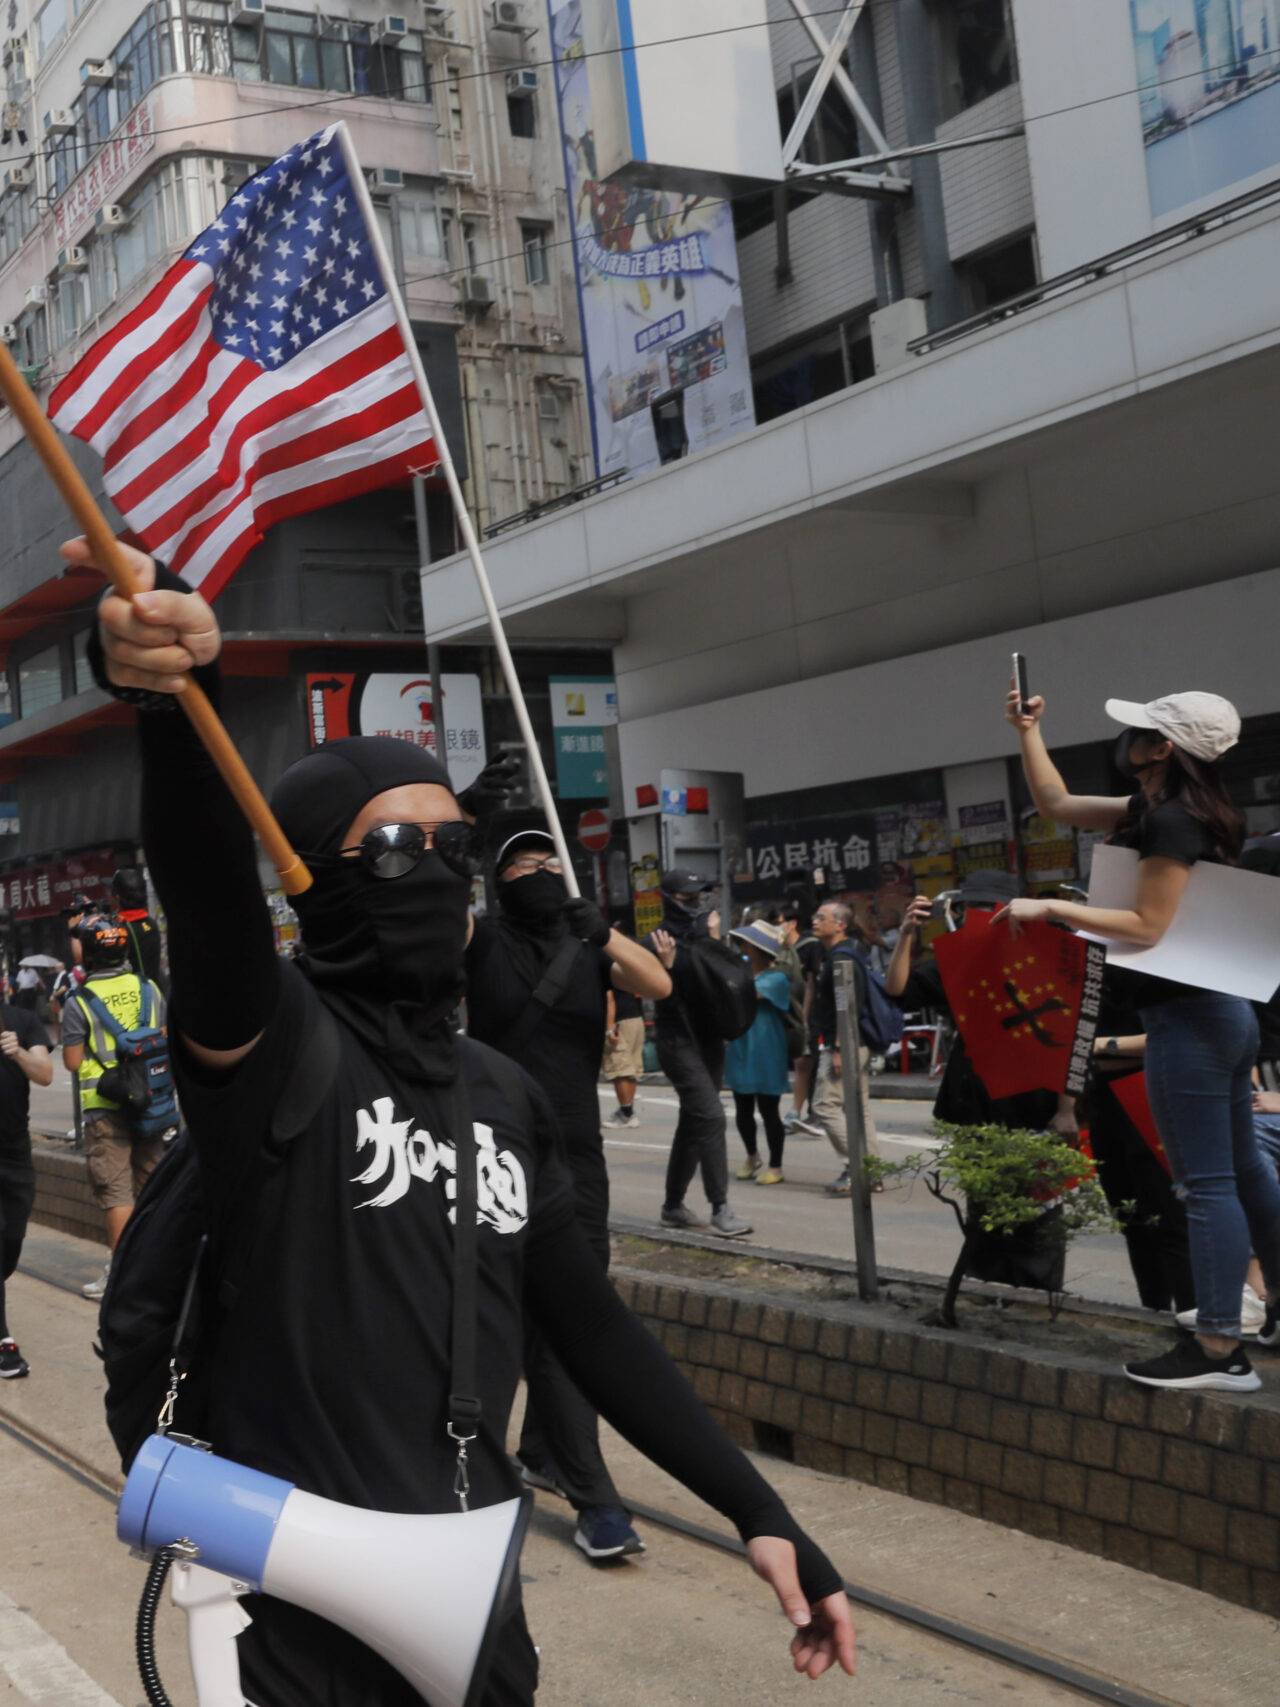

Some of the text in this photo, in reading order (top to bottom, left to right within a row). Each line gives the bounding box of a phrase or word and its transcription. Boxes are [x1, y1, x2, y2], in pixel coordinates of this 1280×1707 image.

[756, 834, 870, 880] 公民抗命
[10, 875, 50, 910] 周大福
[103, 990, 142, 1008] PRES
